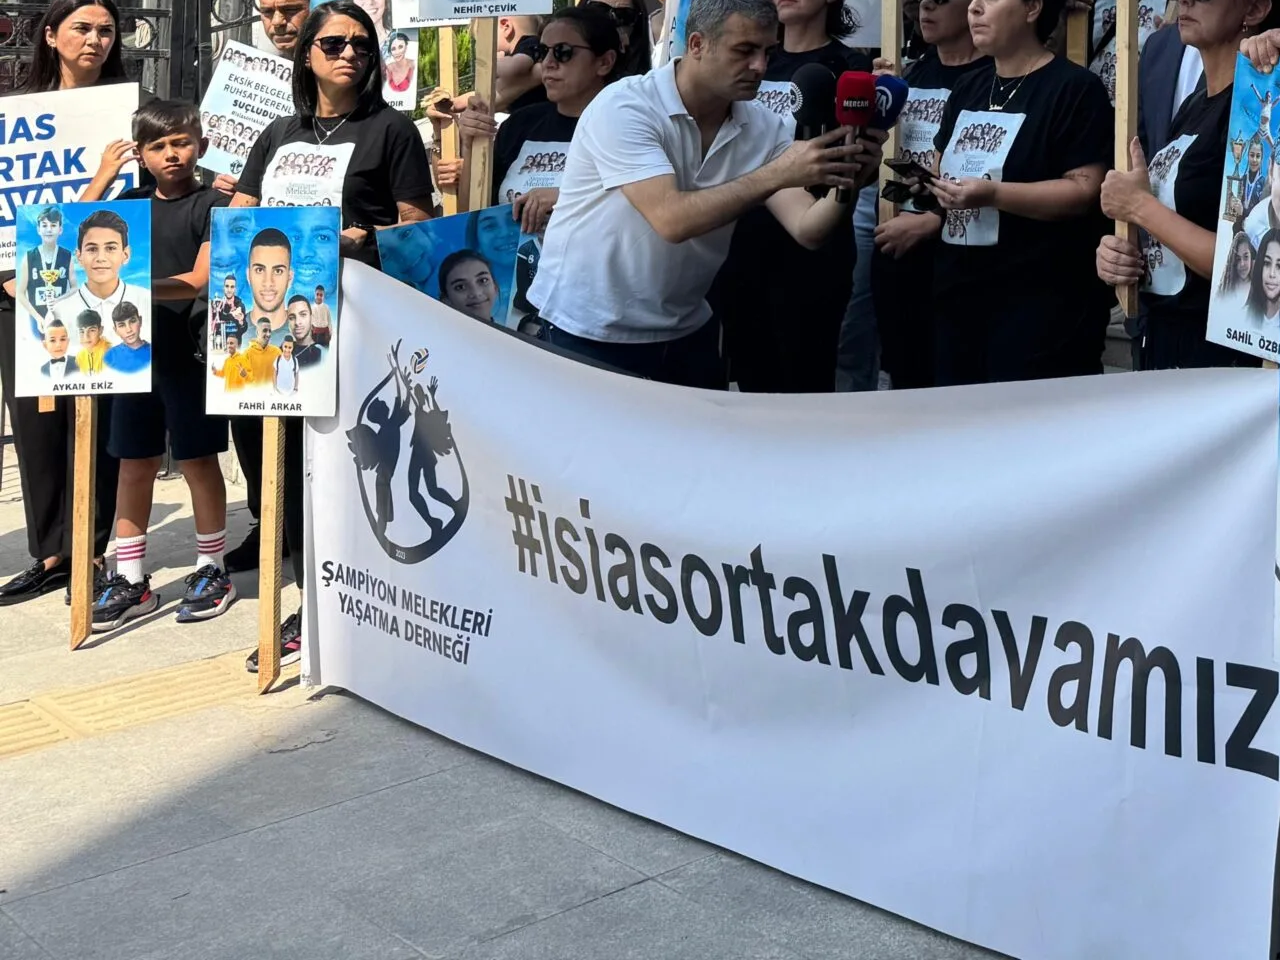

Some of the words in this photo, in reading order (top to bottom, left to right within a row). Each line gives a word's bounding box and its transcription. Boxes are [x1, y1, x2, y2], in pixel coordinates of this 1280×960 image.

[453, 3, 483, 14] NEHİR
[488, 3, 517, 15] ÇEVİK
[228, 73, 253, 89] EKSİK
[224, 84, 258, 102] RUHSAT
[1226, 327, 1253, 347] SAHİL
[52, 382, 85, 392] AYKAN
[90, 380, 114, 390] EKİZ
[238, 400, 266, 412] FAHRİ
[270, 402, 302, 412] ARKAR
[321, 560, 396, 607] ŞAMPİYON
[402, 589, 493, 637] MELEKLERİ
[338, 592, 401, 638] YAŞATMA
[405, 620, 470, 665] DERNEĞİ
[504, 474, 1280, 781] #isiasortakdavamız
